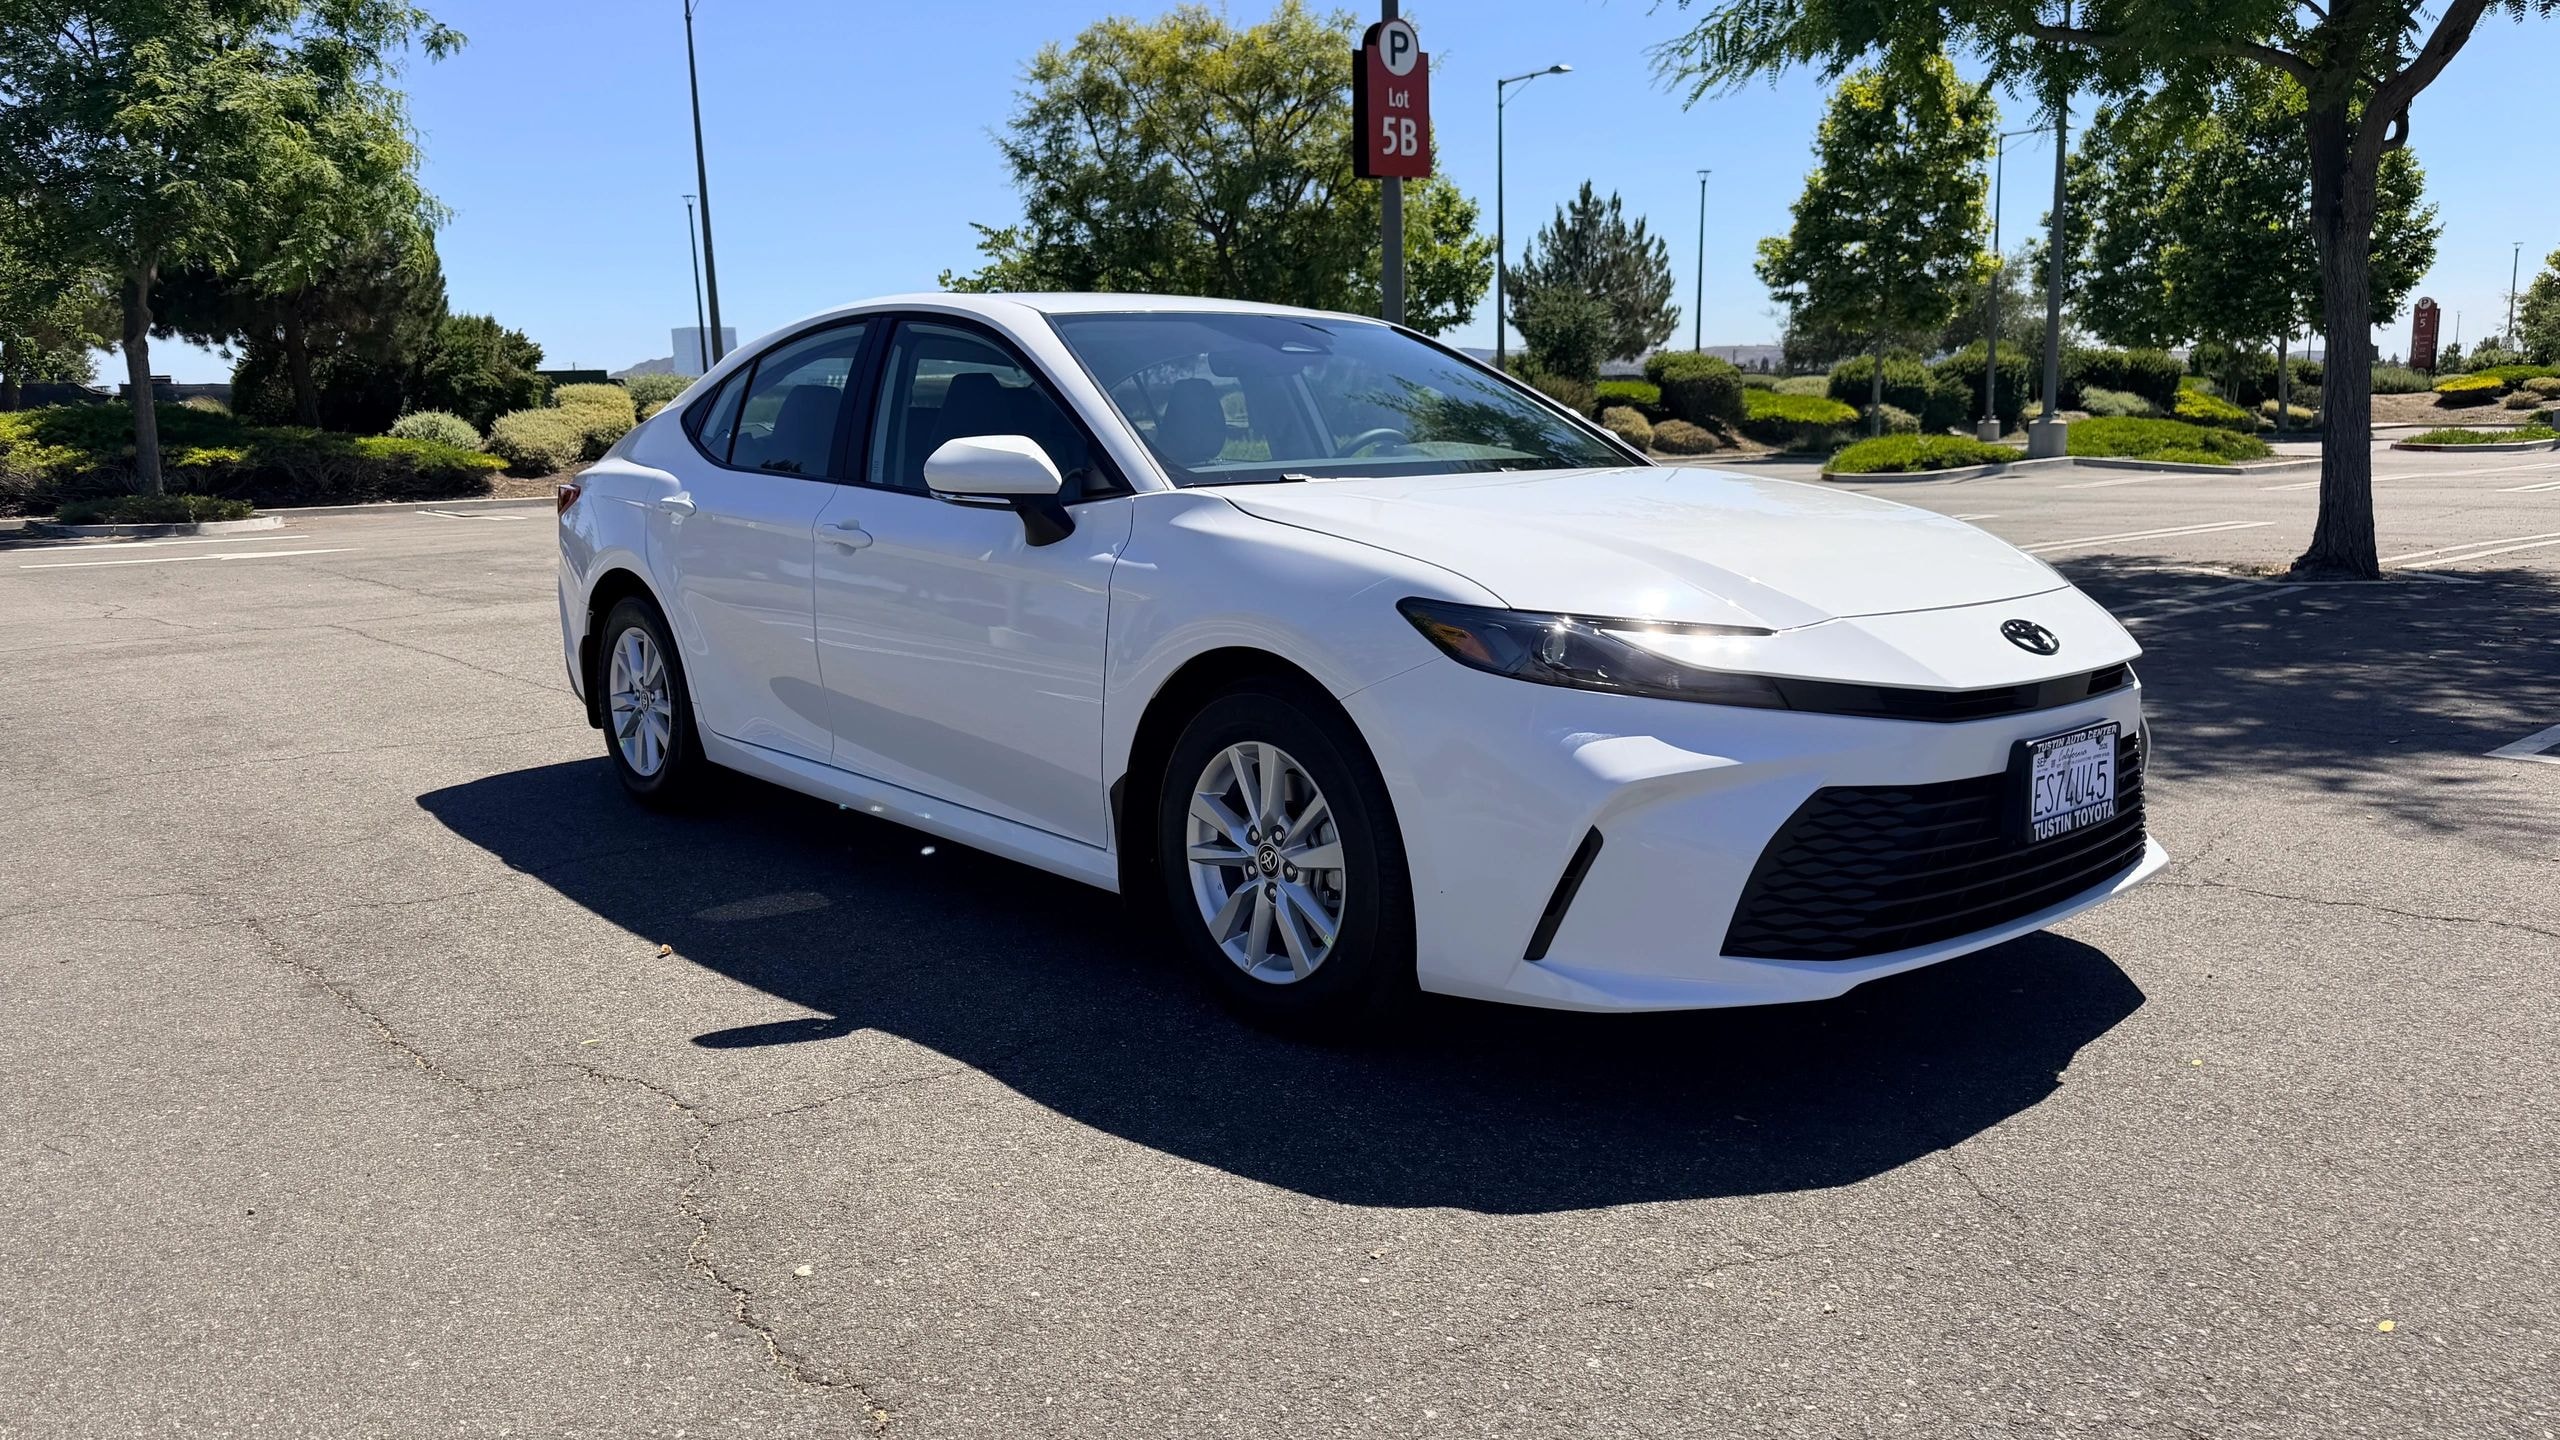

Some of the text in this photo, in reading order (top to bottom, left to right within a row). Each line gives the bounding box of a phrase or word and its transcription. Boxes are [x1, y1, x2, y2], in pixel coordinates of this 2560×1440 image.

[1389, 29, 1409, 67] P
[1388, 87, 1410, 109] Lot
[1382, 116, 1418, 157] 5B
[2420, 298, 2429, 308] P
[2419, 318, 2426, 328] 5
[2037, 724, 2117, 753] TUSTIN AUTO CENTER
[2059, 747, 2087, 764] California
[2033, 760, 2108, 817] ES74U45
[2033, 800, 2115, 841] TUSTIN TOYOTA
